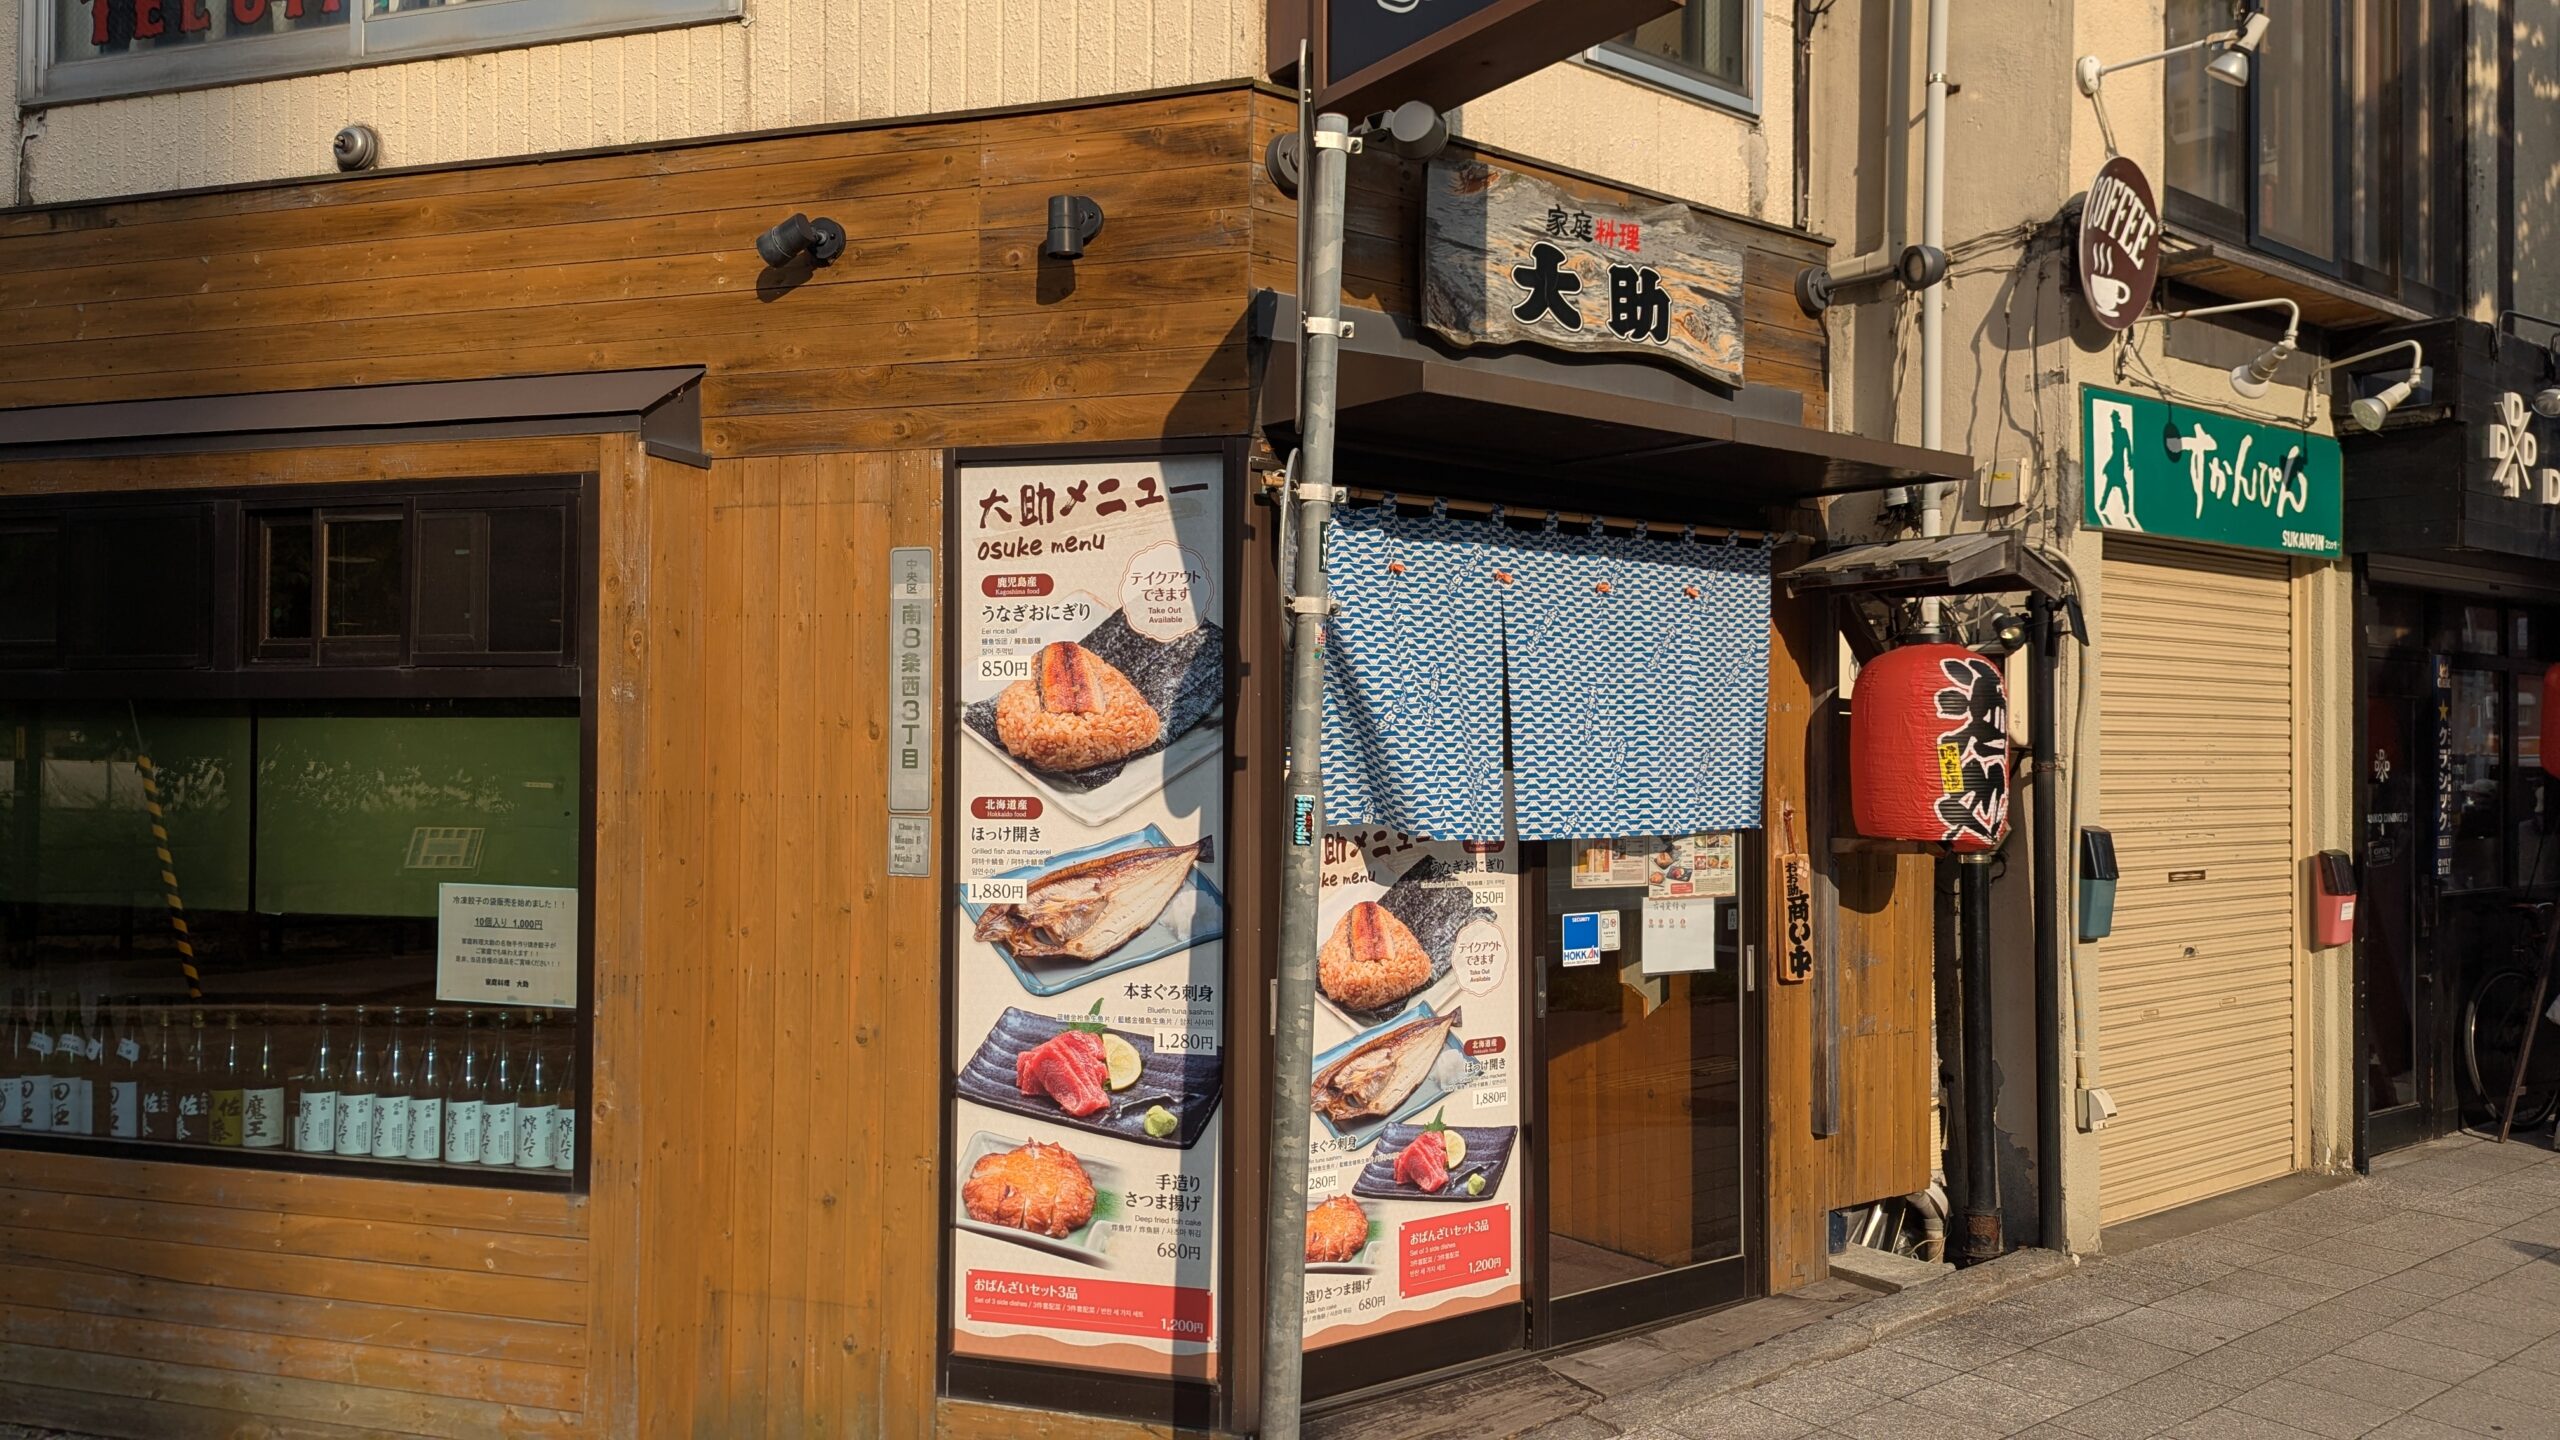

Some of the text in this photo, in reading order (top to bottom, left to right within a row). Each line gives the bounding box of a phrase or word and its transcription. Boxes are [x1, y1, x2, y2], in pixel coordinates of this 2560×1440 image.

[1546, 204, 1641, 252] 家庭料理
[2087, 176, 2155, 270] COFFEE
[1511, 240, 1672, 346] 大助
[2166, 423, 2307, 519] すかんぴん
[979, 477, 1208, 528] 大助メニュー
[977, 533, 1105, 560] osuke menu
[2282, 530, 2324, 551] SUKANPIN
[997, 576, 1037, 588] 鹿児島産
[1130, 570, 1201, 585] テイクアウト
[1141, 587, 1190, 601] できます
[982, 603, 1091, 623] うなぎおにぎり
[1148, 606, 1182, 615] Take Out
[1148, 616, 1183, 624] Available
[901, 559, 922, 769] 中央区 南8条西3丁目
[981, 660, 1028, 677] 850円
[2438, 726, 2448, 831] クラシック
[985, 799, 1028, 810] 北海道産
[971, 826, 1041, 843] ほっけ開き
[1324, 830, 1430, 866] 助メニュー
[1430, 859, 1505, 877] うなぎおにぎり
[1320, 870, 1376, 888] ke menu
[971, 883, 1024, 899] 1,880円
[1475, 891, 1504, 905] 850円
[513, 918, 543, 930] 1,000円
[1785, 862, 1813, 979] おお助 商い中
[1458, 940, 1502, 953] テイクアウト
[1465, 953, 1496, 966] できます
[485, 978, 529, 988] 家庭料理 大助
[1124, 982, 1214, 1002] 本まぐろ刺身
[1189, 1008, 1214, 1016] sashimi
[1157, 1032, 1213, 1050] 1,280円
[1464, 1057, 1506, 1073] ほっけ開き
[1476, 1091, 1507, 1106] 1,880円
[245, 1095, 267, 1138] 魔王
[1310, 1136, 1357, 1154] まぐろ刺身
[1155, 1174, 1200, 1192] 手造り
[1308, 1175, 1337, 1190] 280円
[1125, 1191, 1202, 1212] さつま揚げ
[1134, 1215, 1153, 1223] Deep
[1154, 1216, 1170, 1224] fried
[1171, 1217, 1184, 1225] fish
[1410, 1218, 1489, 1246] おばんざいセット3品
[1157, 1242, 1201, 1260] 680円
[1468, 1257, 1502, 1275] 1,200円
[974, 1278, 1078, 1300] おばんざいセット3品
[1305, 1277, 1372, 1305] 造りさつま揚げ
[1358, 1295, 1386, 1311] 680円
[1160, 1317, 1203, 1334] 1,200円
